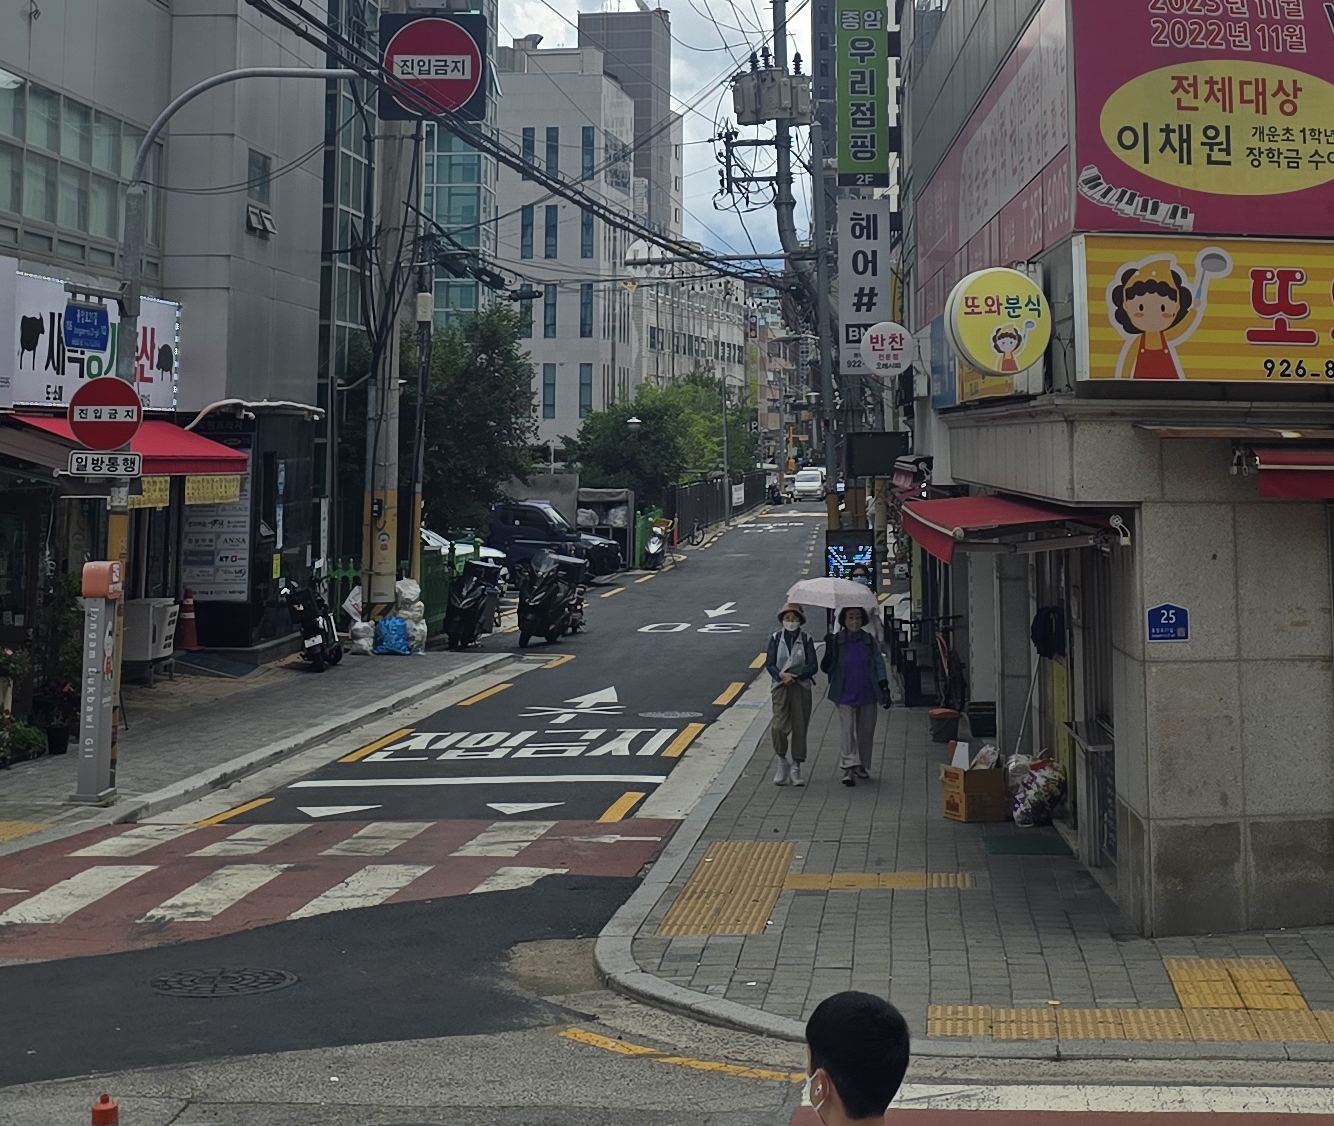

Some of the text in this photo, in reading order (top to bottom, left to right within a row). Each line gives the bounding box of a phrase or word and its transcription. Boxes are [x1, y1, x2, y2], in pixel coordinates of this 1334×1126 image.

[840, 10, 883, 30] 종암
[400, 59, 465, 76] 진입금지
[848, 37, 878, 163] 우리점핑
[1170, 76, 1303, 117] 전체대상
[1117, 123, 1295, 166] 이채원 개운초
[1245, 147, 1302, 170] 장학금
[856, 174, 873, 184] 2F
[964, 294, 1041, 318] 또와분식
[870, 333, 904, 351] 반찬
[78, 408, 134, 420] 진입금지
[75, 455, 137, 473] 일방통행
